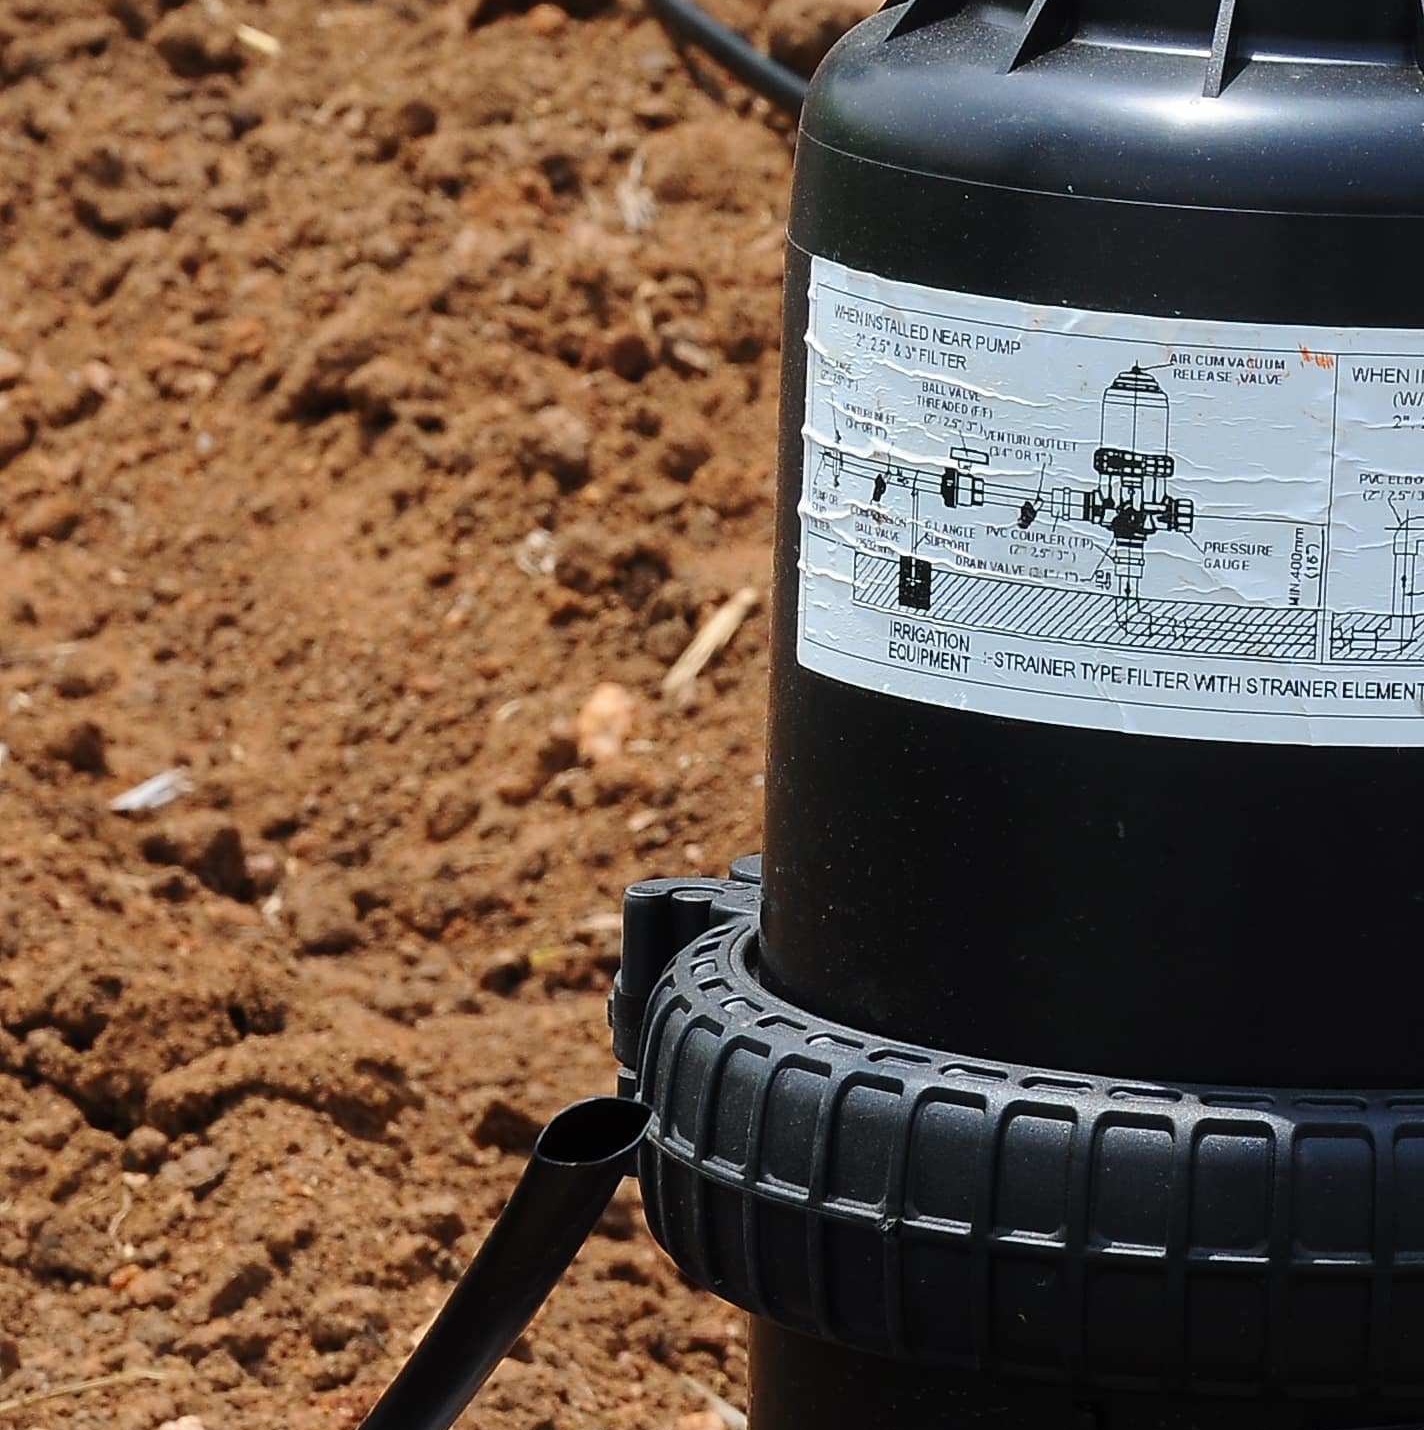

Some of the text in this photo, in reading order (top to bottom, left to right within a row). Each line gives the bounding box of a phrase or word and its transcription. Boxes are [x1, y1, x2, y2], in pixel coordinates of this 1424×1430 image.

[834, 303, 1021, 356] WHEN INSTALLED NEAR PUMP
[919, 348, 967, 370] FILTER
[1170, 353, 1285, 370] AIR CUM VACUUM
[1173, 369, 1282, 385] RELEASE VALVE
[1352, 367, 1409, 384] WHEN
[922, 382, 947, 395] BALL
[917, 395, 968, 414] THREADED
[984, 429, 1078, 452] VENTURI OUTLET
[1360, 474, 1383, 485] PVC
[986, 526, 1007, 538] PVC
[1011, 529, 1065, 545] COUPLER
[1204, 541, 1272, 556] PRESSURE
[956, 555, 987, 569] DRAIN
[990, 561, 1025, 576] VALVE
[1204, 558, 1250, 570] GAUGE
[889, 620, 970, 653] IRRIGATION
[888, 641, 971, 673] EQUIPMENT
[1080, 662, 1122, 683] TYPE
[1127, 668, 1190, 691] FILTER
[1194, 673, 1241, 694] WITH
[1246, 676, 1337, 699] STRAINER
